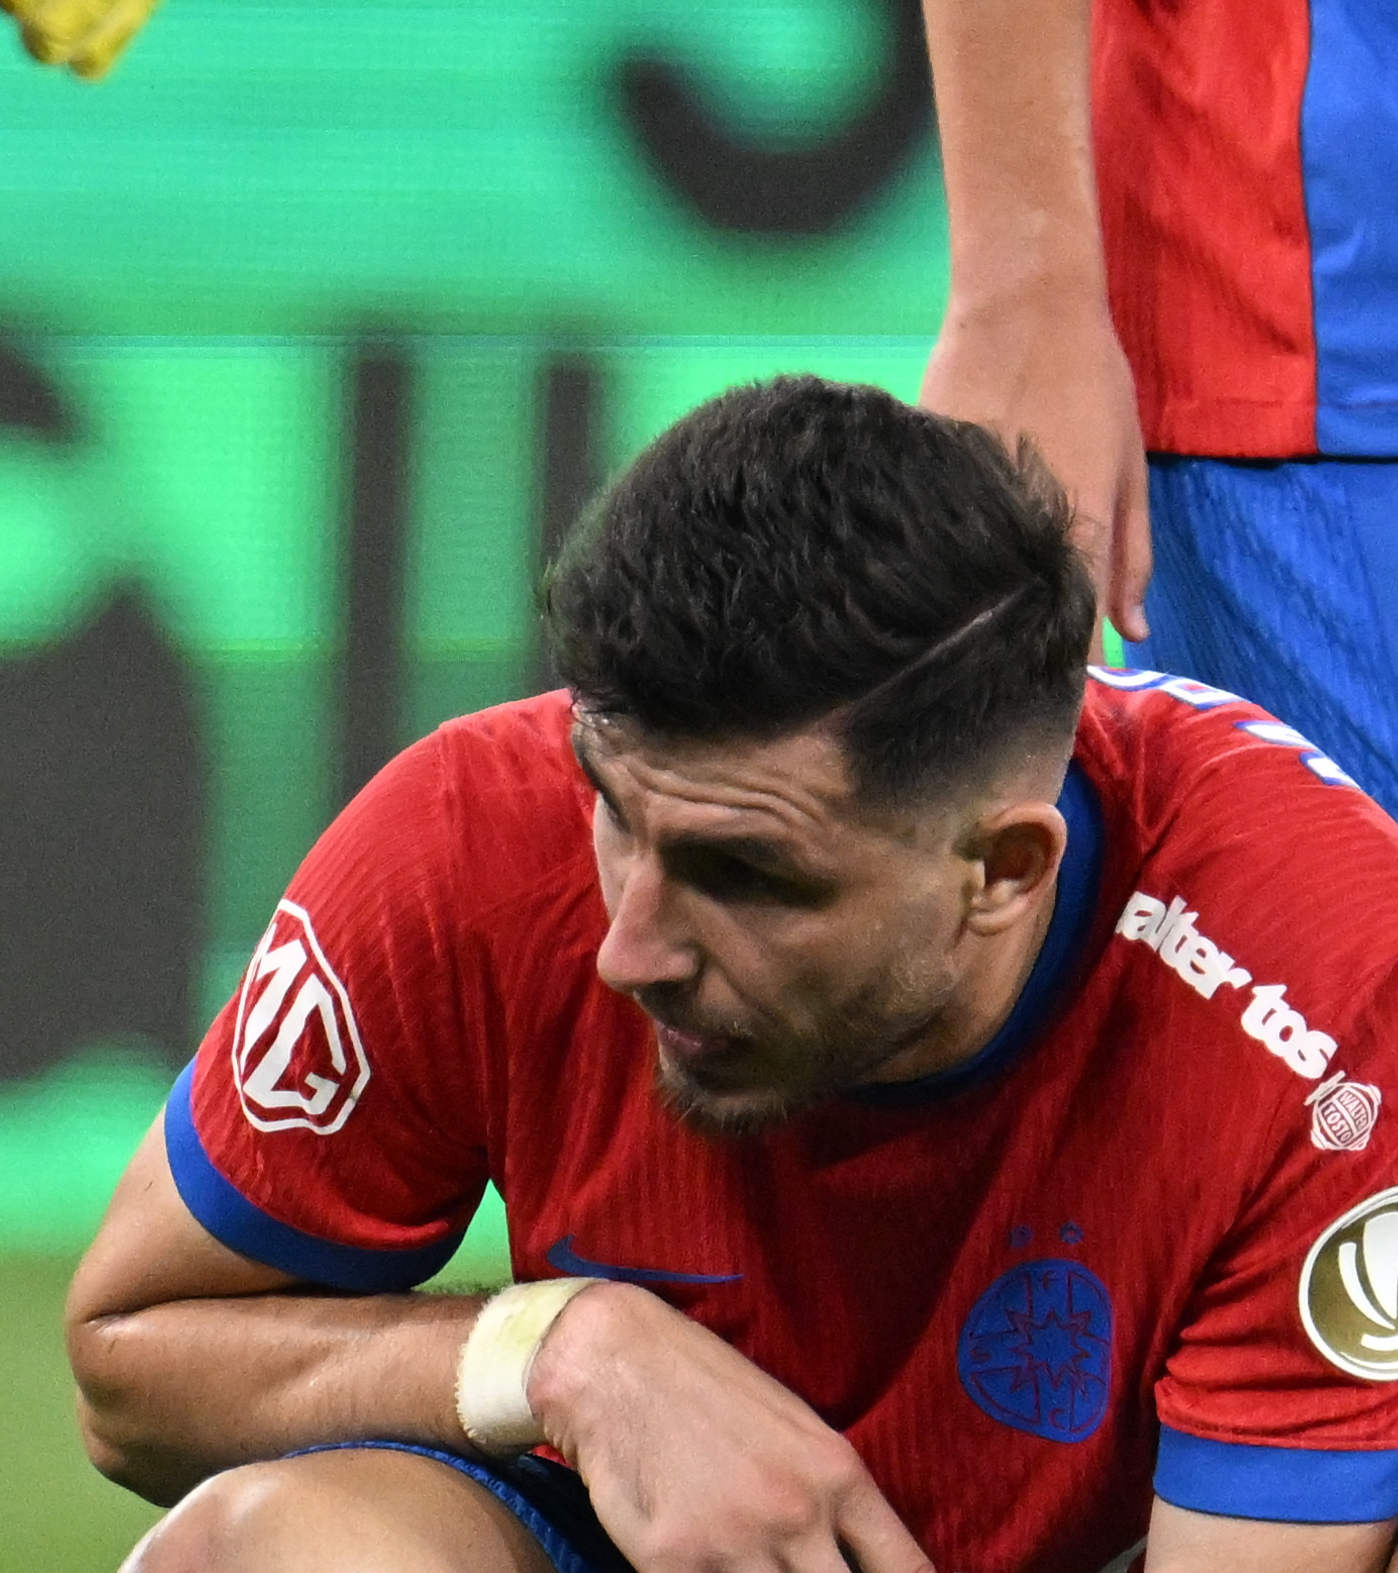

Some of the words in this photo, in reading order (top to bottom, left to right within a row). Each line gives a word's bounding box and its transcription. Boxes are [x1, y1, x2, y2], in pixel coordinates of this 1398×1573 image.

[239, 922, 347, 1115] MG
[1115, 891, 1252, 1000] alter
[1241, 984, 1339, 1079] tos
[1323, 1103, 1352, 1142] TOSTO
[1339, 1091, 1368, 1131] WALTER
